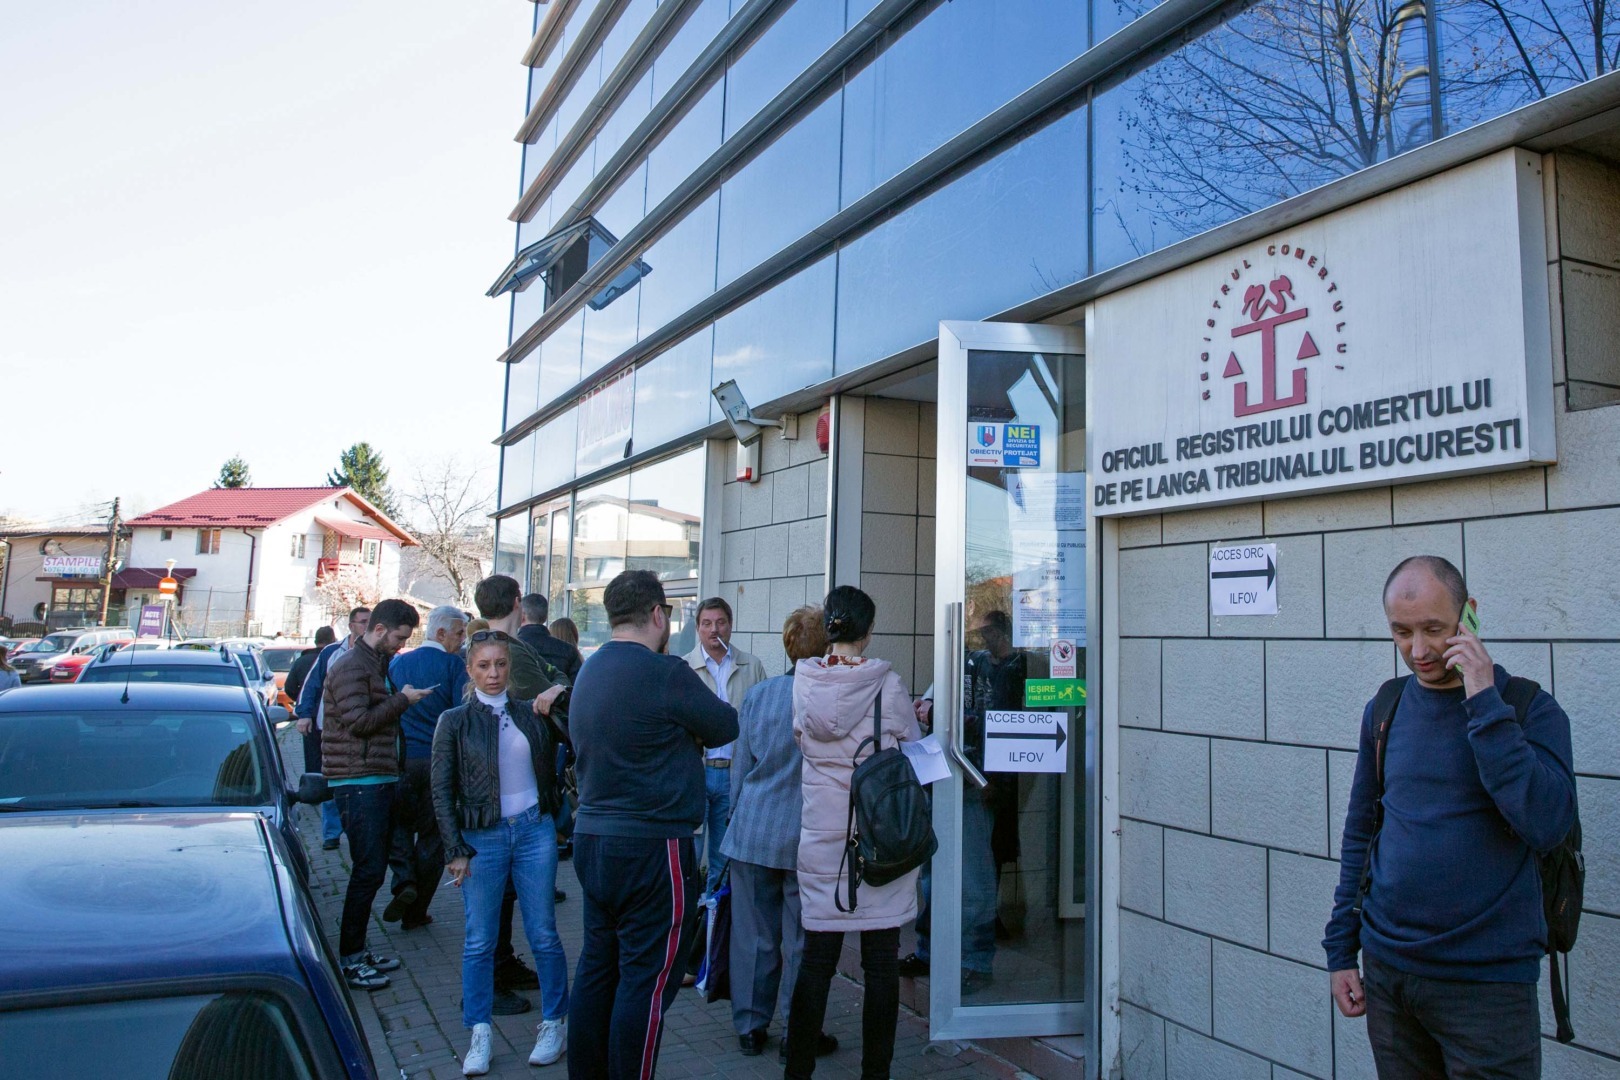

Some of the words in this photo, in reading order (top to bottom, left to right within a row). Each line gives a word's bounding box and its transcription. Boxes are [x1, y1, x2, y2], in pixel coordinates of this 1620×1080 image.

[1200, 260, 1252, 401] REGISTRUL
[1267, 244, 1347, 371] COMERTULUI
[1102, 442, 1168, 474] OFICIUL
[1176, 413, 1312, 461] REGISTRULUI
[1318, 377, 1492, 436] COMERTULUI
[1003, 449, 1038, 457] PROTEJAT
[1094, 482, 1117, 506] DE
[1120, 478, 1143, 503] PE
[1147, 469, 1210, 500] LANGA
[1214, 446, 1354, 490] TRIBUNALUL
[1360, 417, 1522, 470] BUCURESTI
[1212, 548, 1242, 561] ACCES
[1243, 546, 1264, 559] ORC
[44, 557, 100, 567] STAMPILE
[1229, 591, 1258, 605] ILFOV
[986, 713, 1026, 725] ACCES
[1028, 714, 1053, 725] ORC
[1009, 751, 1044, 763] ILFOV
